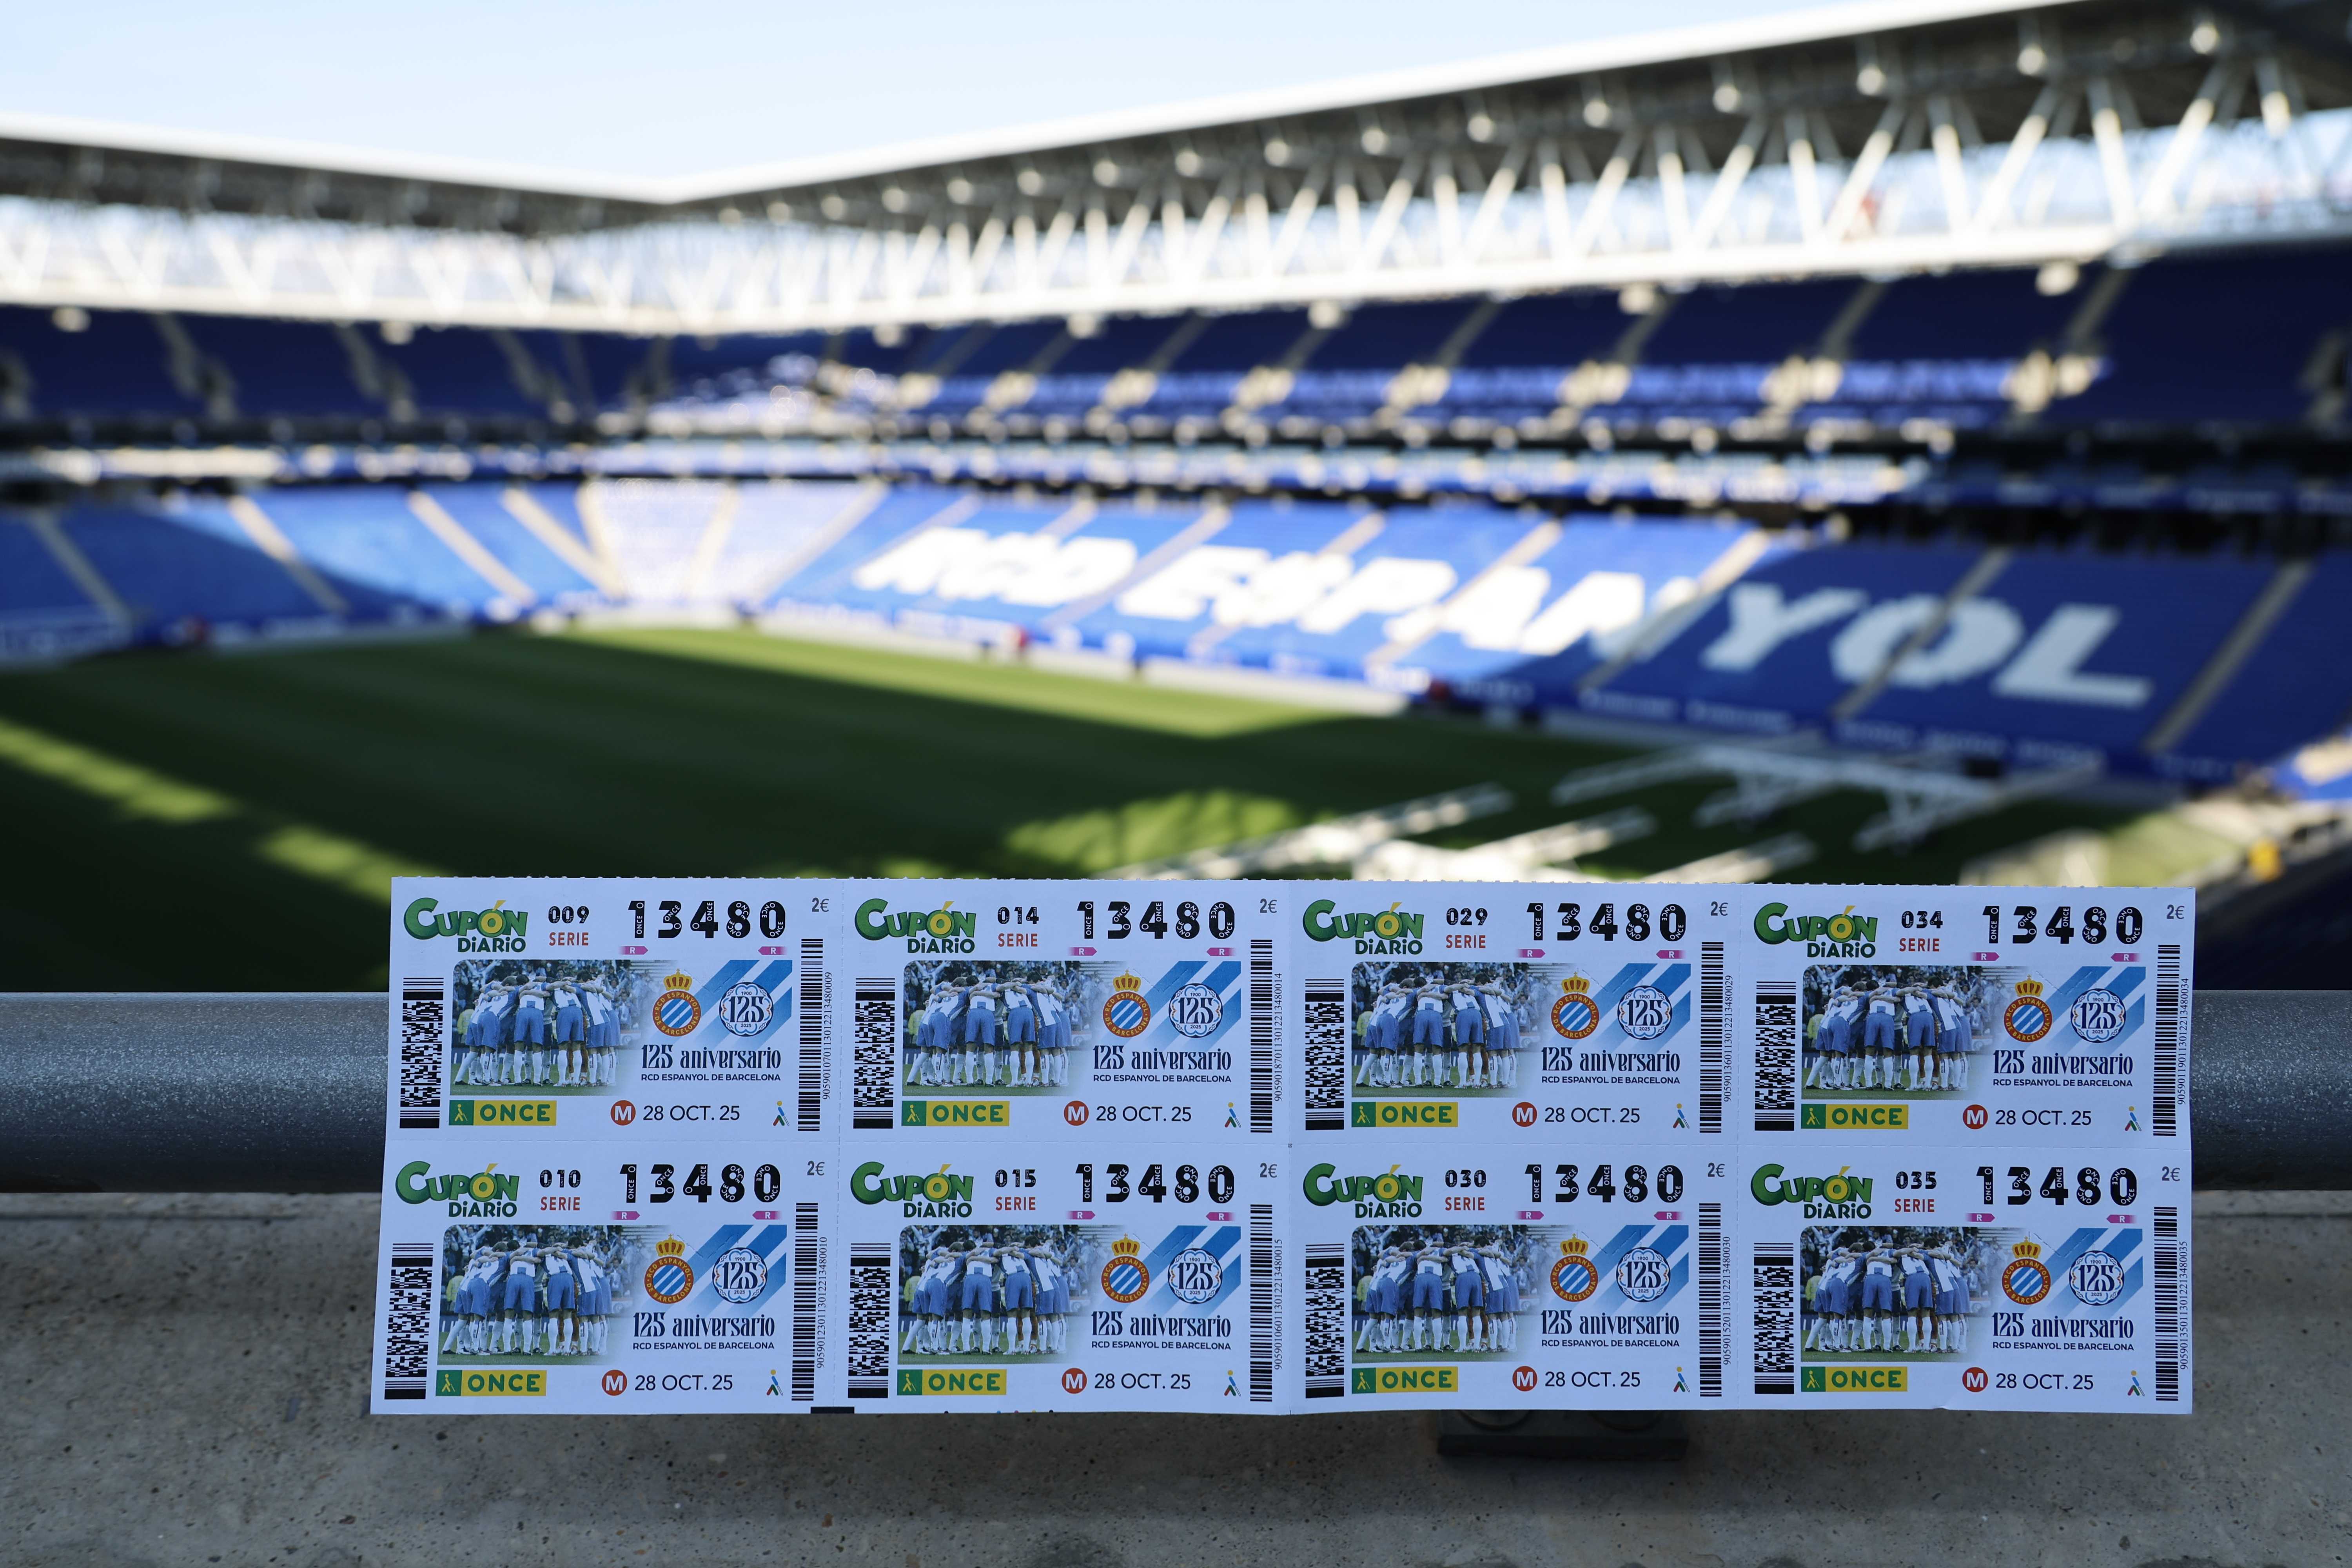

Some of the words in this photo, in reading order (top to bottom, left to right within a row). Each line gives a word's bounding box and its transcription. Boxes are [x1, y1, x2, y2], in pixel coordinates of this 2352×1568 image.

[812, 898, 829, 912] 2€
[1260, 898, 1277, 913] 2€
[1711, 901, 1728, 916] 2€
[2167, 905, 2184, 919] 2€
[548, 906, 589, 923] 009
[628, 901, 785, 938] 13480
[998, 907, 1039, 924] 014
[1077, 902, 1234, 939] 13480
[1446, 908, 1488, 925] 029
[1527, 903, 1686, 941] 13480
[1902, 911, 1943, 928] 034
[1983, 906, 2142, 944] 13480
[549, 932, 588, 946] SERIE
[998, 933, 1038, 947] SERIE
[1446, 935, 1486, 948] SERIE
[1899, 938, 1939, 951] SERIE
[728, 996, 764, 1023] 125
[2081, 1002, 2117, 1029] 125
[642, 1045, 673, 1068] 125
[680, 1047, 780, 1068] aniversario
[1093, 1045, 1124, 1069] 125
[1132, 1048, 1231, 1070] aniversario
[1541, 1047, 1572, 1071] 125
[1580, 1050, 1680, 1071] aniversario
[1993, 1050, 2025, 1074] 125
[2032, 1053, 2133, 1074] aniversario
[480, 1104, 550, 1122] ONCE
[614, 1106, 632, 1120] M
[643, 1105, 663, 1120] 28
[670, 1105, 714, 1121] OCT.
[720, 1105, 740, 1120] 25
[933, 1105, 1003, 1122] ONCE
[1066, 1107, 1084, 1121] M
[1096, 1106, 1116, 1121] 28
[1123, 1106, 1166, 1121] OCT.
[1172, 1107, 1191, 1122] 25
[1383, 1105, 1452, 1123] ONCE
[1515, 1107, 1533, 1122] M
[1545, 1107, 1565, 1122] 28
[1571, 1107, 1615, 1123] OCT.
[1620, 1108, 1640, 1123] 25
[1831, 1108, 1902, 1125] ONCE
[1965, 1110, 1984, 1124] M
[1996, 1110, 2016, 1125] 28
[2022, 1110, 2066, 1125] OCT.
[2071, 1111, 2091, 1125] 25
[808, 1161, 825, 1176] 2€
[1260, 1163, 1277, 1178] 2€
[1708, 1163, 1725, 1177] 2€
[2161, 1167, 2180, 1181] 2€
[540, 1170, 581, 1187] 010
[620, 1164, 780, 1203] 13480
[995, 1169, 1036, 1187] 015
[1076, 1164, 1234, 1203] 13480
[1445, 1170, 1486, 1187] 030
[1525, 1164, 1683, 1203] 13480
[1896, 1171, 1936, 1189] 035
[1976, 1167, 2137, 1206] 13480
[541, 1196, 580, 1210] SERIE
[996, 1197, 1035, 1210] SERIE
[1445, 1197, 1485, 1210] SERIE
[1895, 1199, 1935, 1212] SERIE
[722, 1262, 758, 1290] 125
[2080, 1264, 2117, 1292] 125
[633, 1312, 665, 1337] 125
[673, 1314, 775, 1336] aniversario
[1091, 1311, 1123, 1335] 125
[1130, 1315, 1230, 1337] aniversario
[1541, 1310, 1572, 1334] 125
[1580, 1312, 1679, 1334] aniversario
[1992, 1312, 2024, 1336] 125
[2032, 1316, 2133, 1338] aniversario
[468, 1374, 540, 1392] ONCE
[604, 1376, 623, 1390] M
[635, 1375, 655, 1390] 28
[662, 1375, 707, 1390] OCT.
[712, 1375, 732, 1390] 25
[929, 1373, 1000, 1391] ONCE
[1064, 1374, 1082, 1389] M
[1095, 1374, 1115, 1388] 28
[1121, 1373, 1165, 1388] OCT.
[1171, 1374, 1190, 1389] 25
[1382, 1370, 1452, 1388] ONCE
[1515, 1372, 1533, 1387] M
[1545, 1372, 1565, 1387] 28
[1572, 1372, 1615, 1387] OCT.
[1621, 1372, 1640, 1387] 25
[1832, 1370, 1902, 1387] ONCE
[1965, 1373, 1984, 1388] M
[1996, 1373, 2016, 1388] 28
[2023, 1374, 2069, 1389] OCT.
[2073, 1375, 2093, 1390] 25
